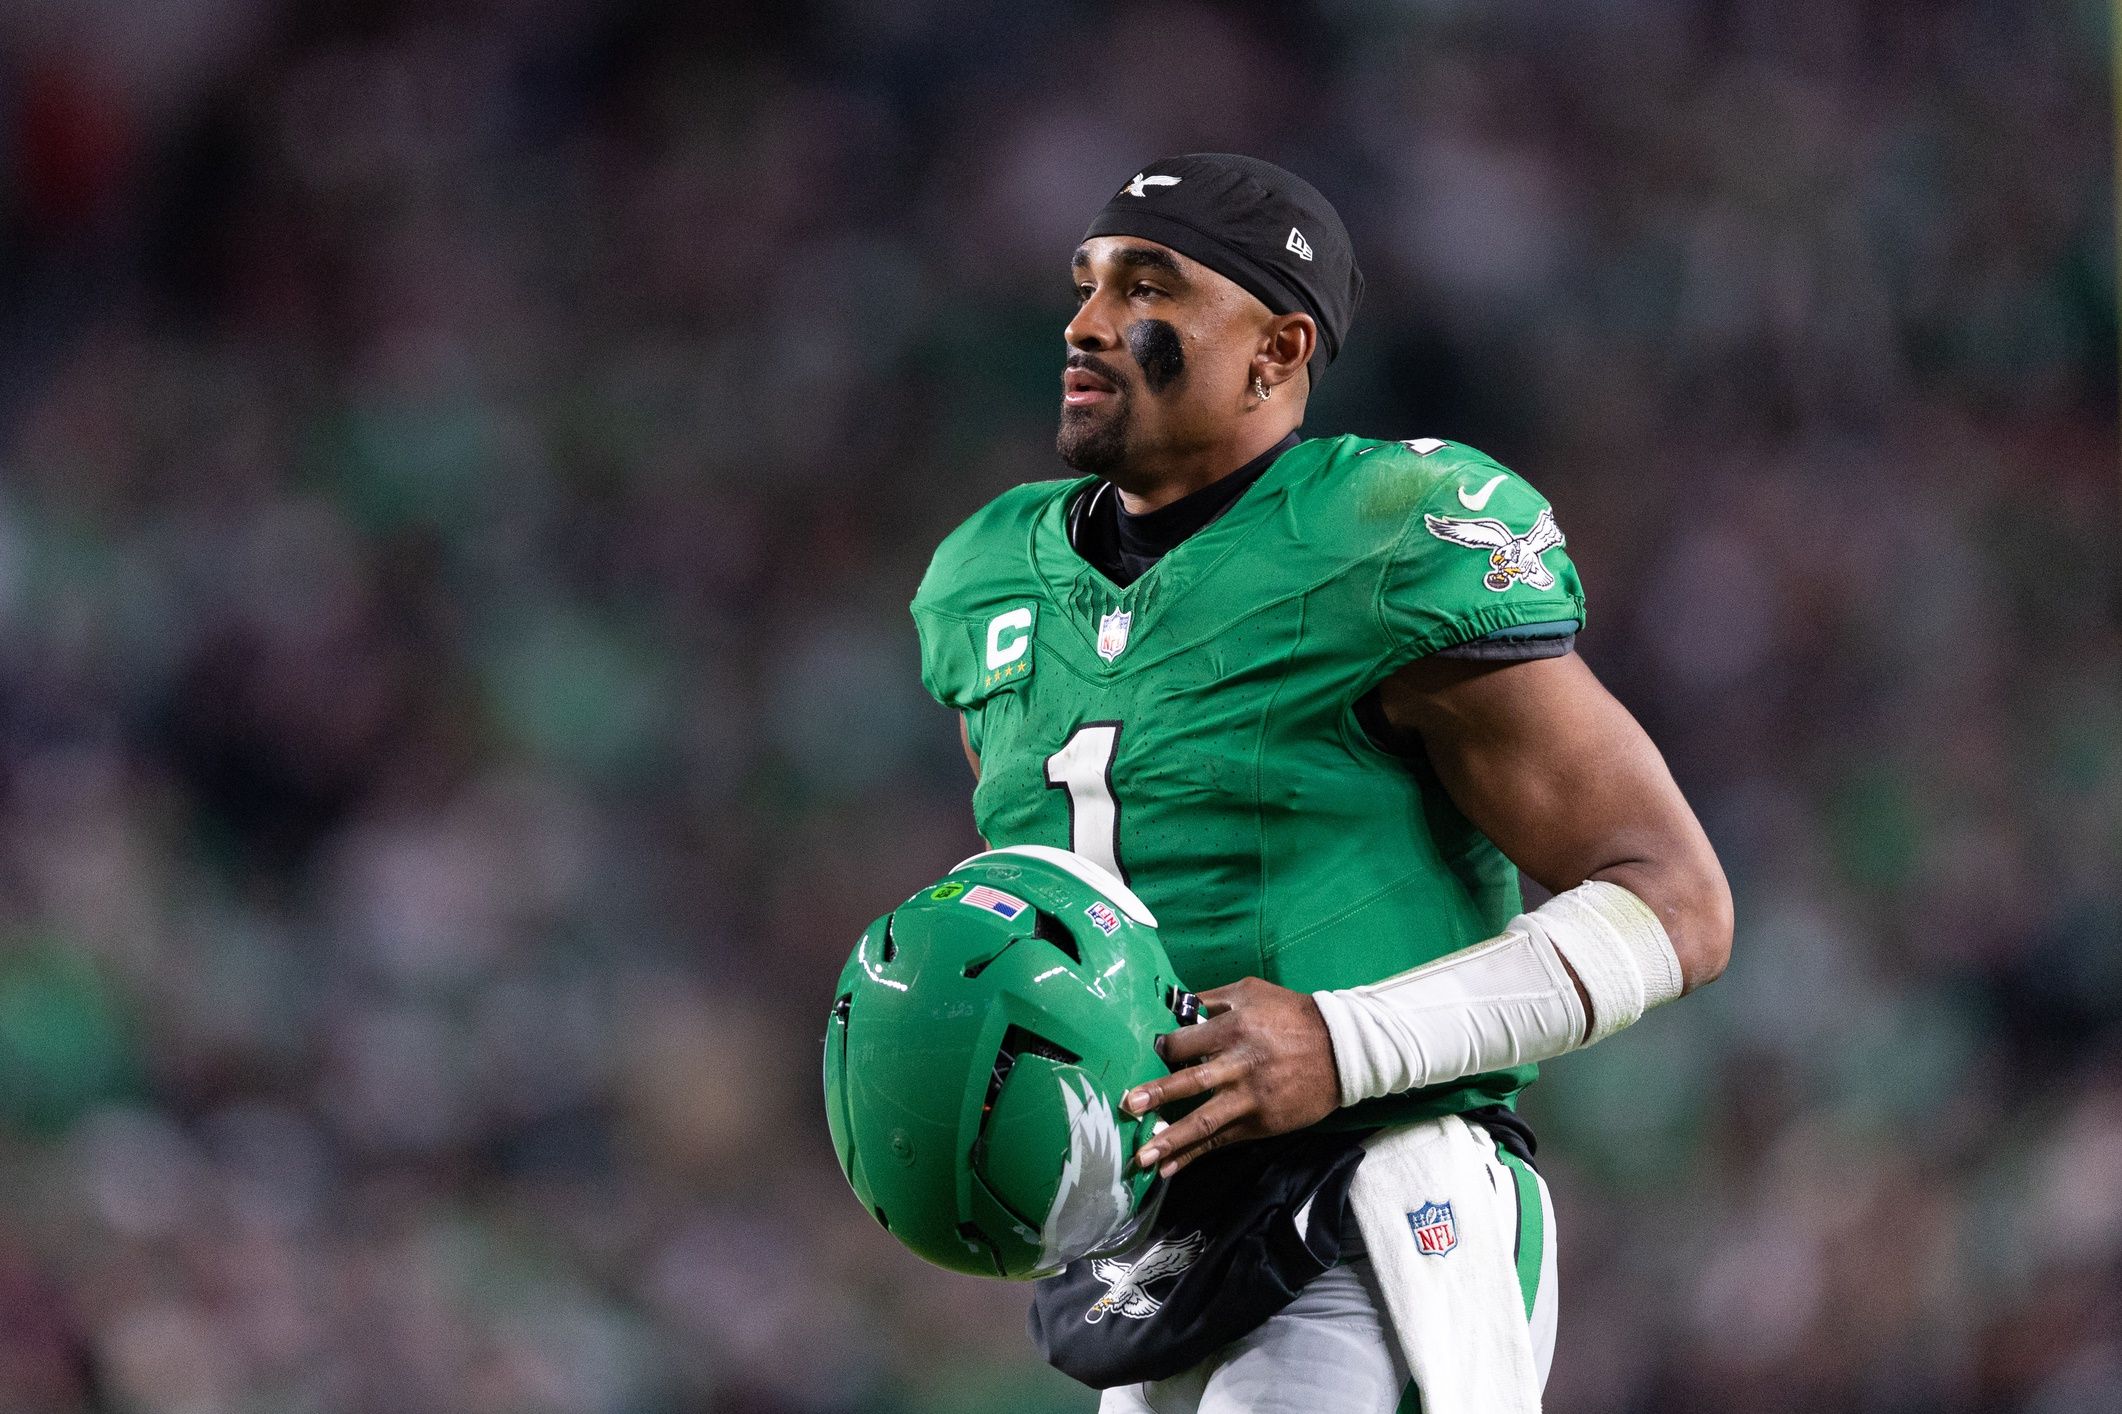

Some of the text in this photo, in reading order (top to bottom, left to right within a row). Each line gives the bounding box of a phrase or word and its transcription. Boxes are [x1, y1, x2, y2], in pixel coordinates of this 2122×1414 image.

[987, 608, 1031, 671] C
[1044, 720, 1131, 889] 1
[1098, 904, 1117, 926] NFL
[1417, 1224, 1455, 1250] NFL
